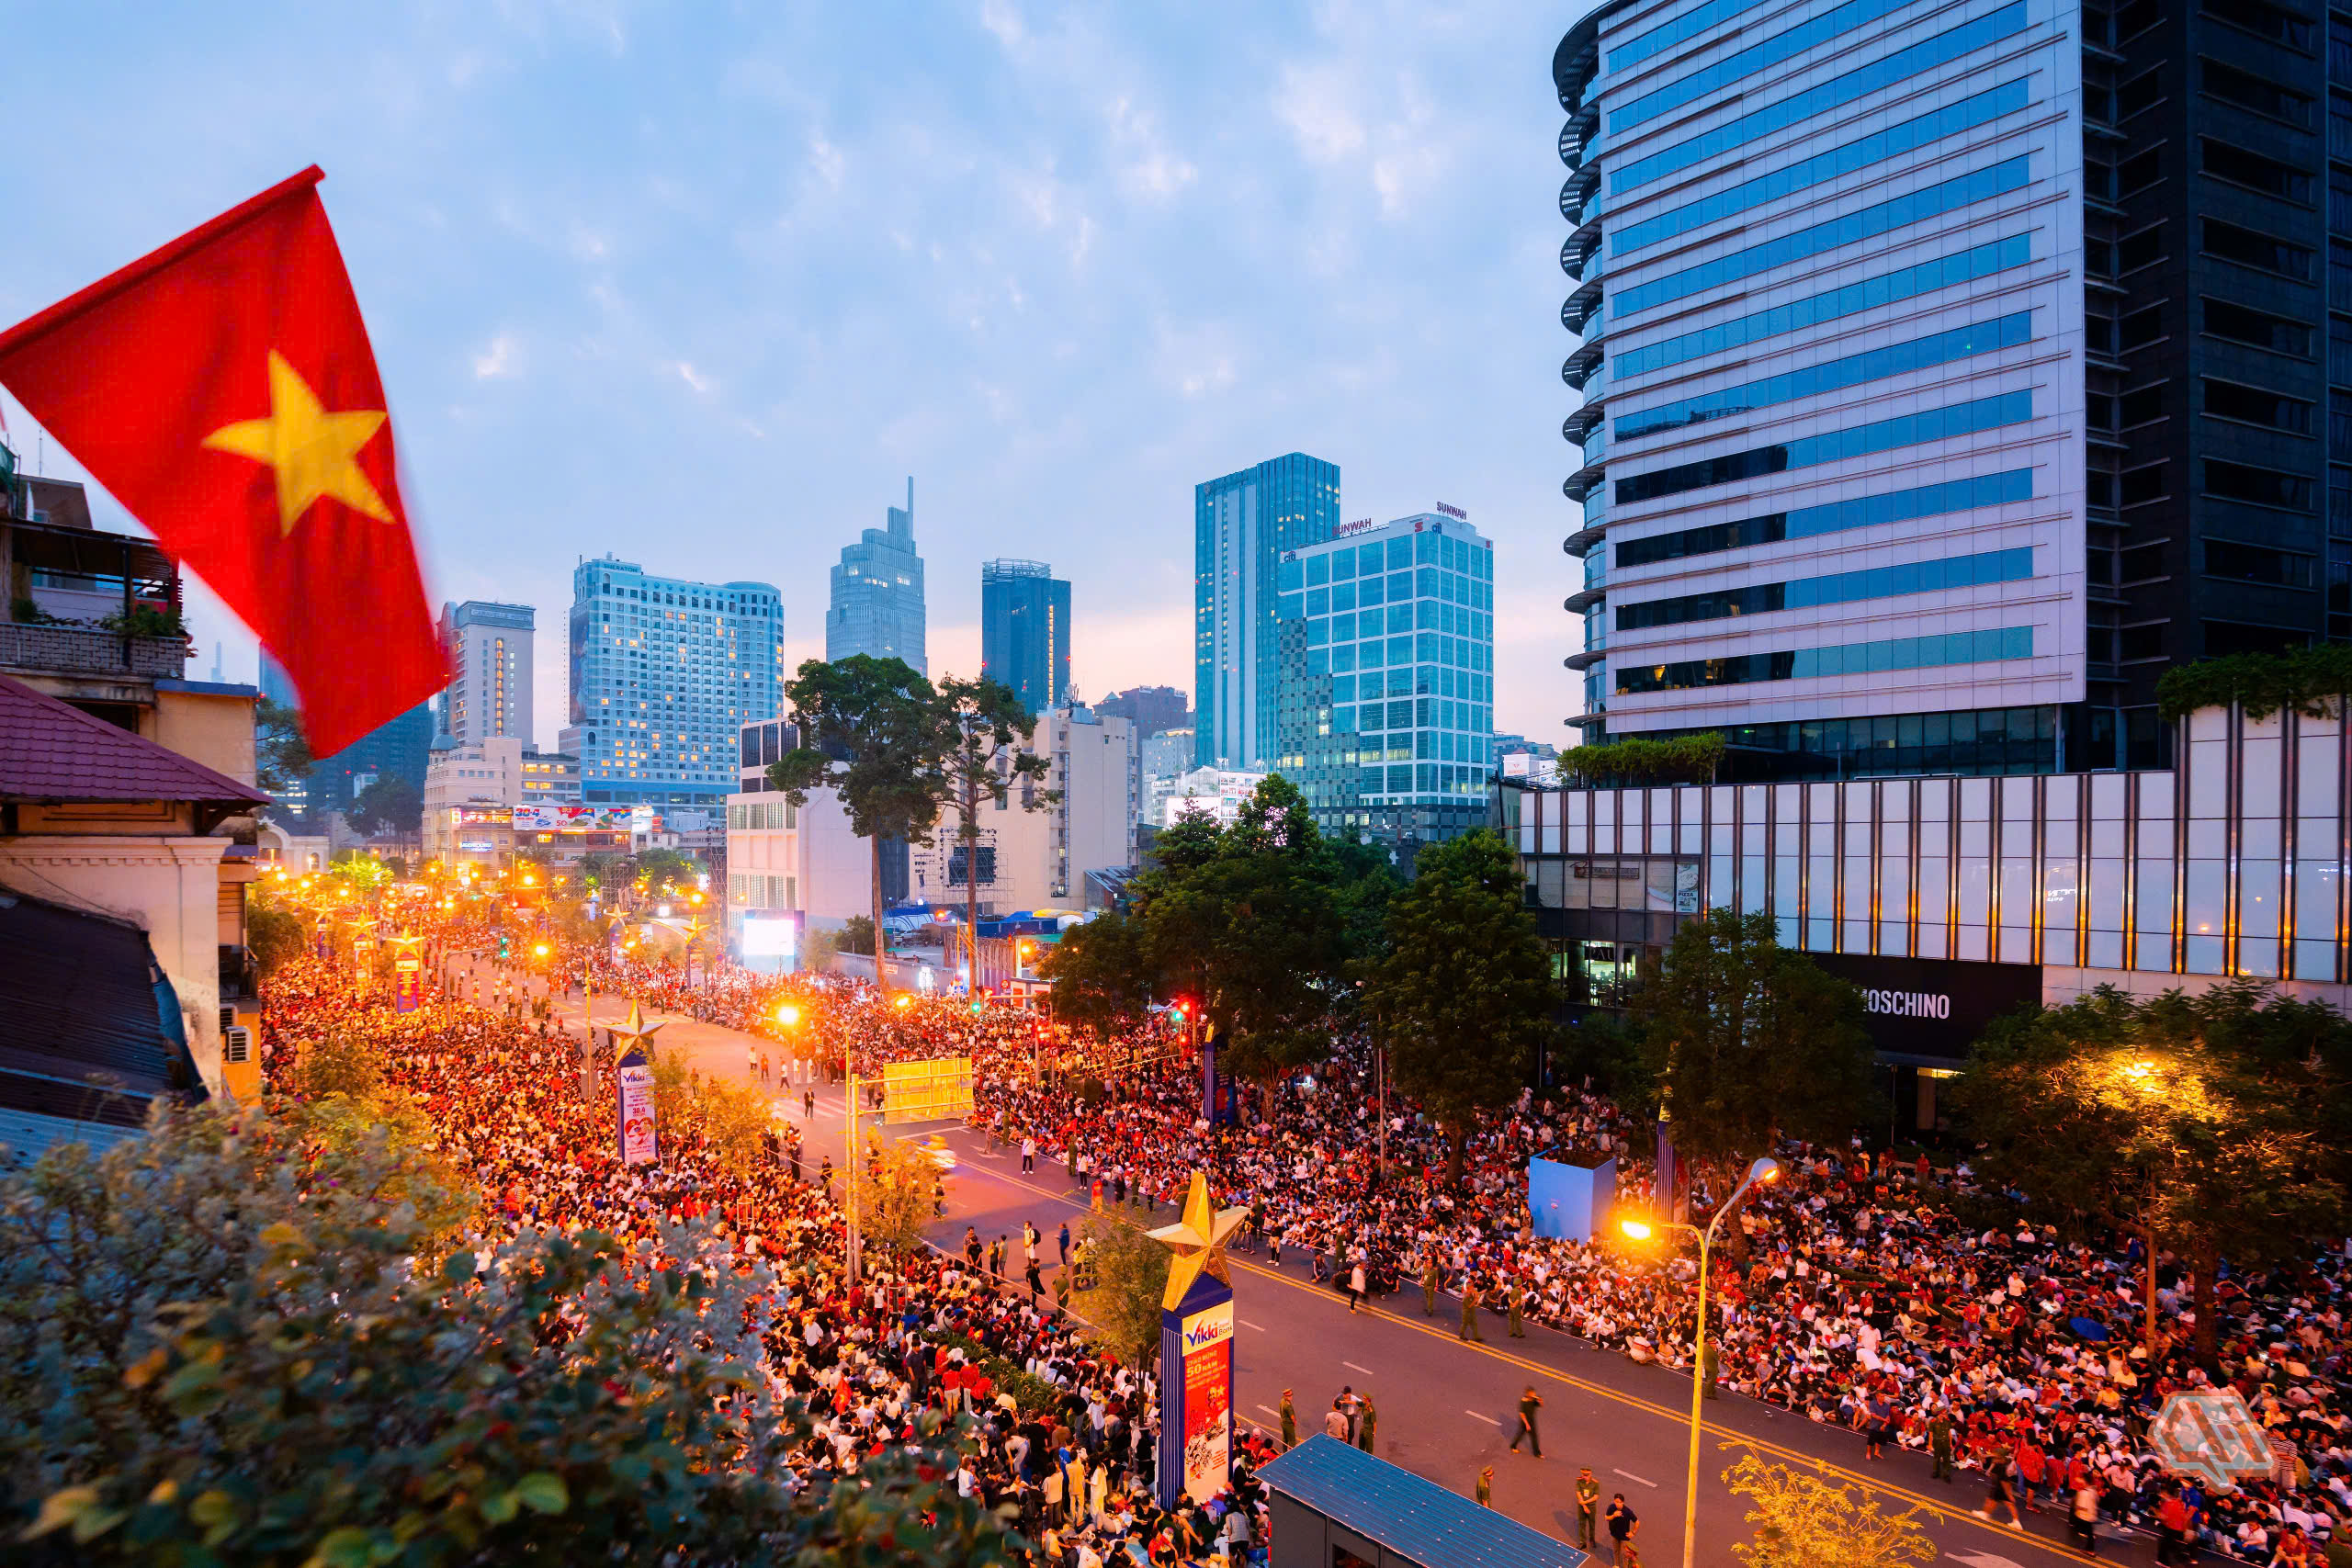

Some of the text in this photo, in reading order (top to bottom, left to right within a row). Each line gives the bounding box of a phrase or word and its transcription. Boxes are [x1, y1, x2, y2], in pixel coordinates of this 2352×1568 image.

[1436, 501, 1467, 520] SUNWAH
[1332, 518, 1372, 537] SUNWAH
[1186, 1320, 1218, 1347] Vikki
[1186, 1363, 1202, 1378] 50
